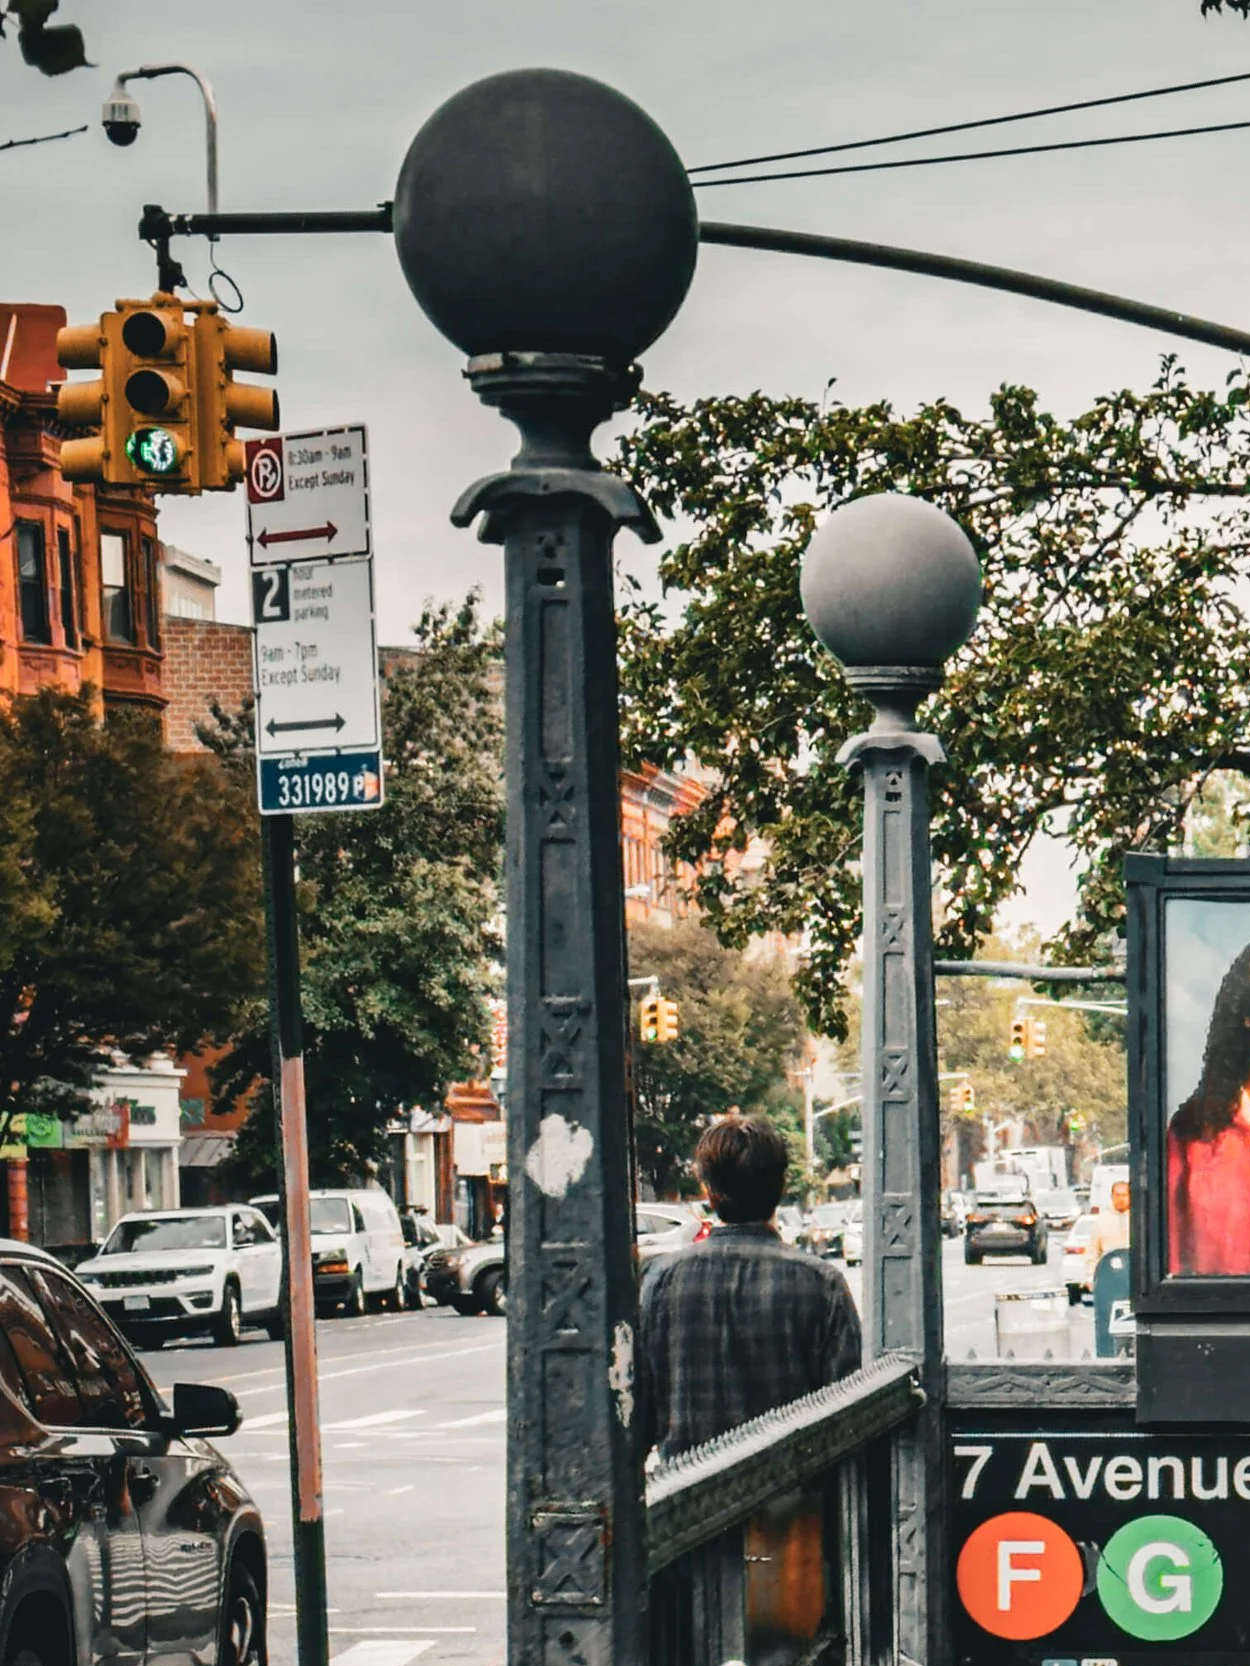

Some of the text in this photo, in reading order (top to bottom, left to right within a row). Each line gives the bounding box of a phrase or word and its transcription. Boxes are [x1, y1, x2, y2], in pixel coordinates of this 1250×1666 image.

[331, 445, 352, 460] 9am
[288, 469, 355, 491] Except Sunday
[261, 570, 282, 618] 2
[293, 582, 333, 600] metered
[294, 605, 329, 622] parking
[260, 645, 284, 663] 9am
[295, 641, 318, 662] 7pm
[261, 664, 341, 687] Except Sunday
[277, 771, 350, 807] 331989
[952, 1445, 994, 1500] 7
[997, 1540, 1193, 1614] F G
